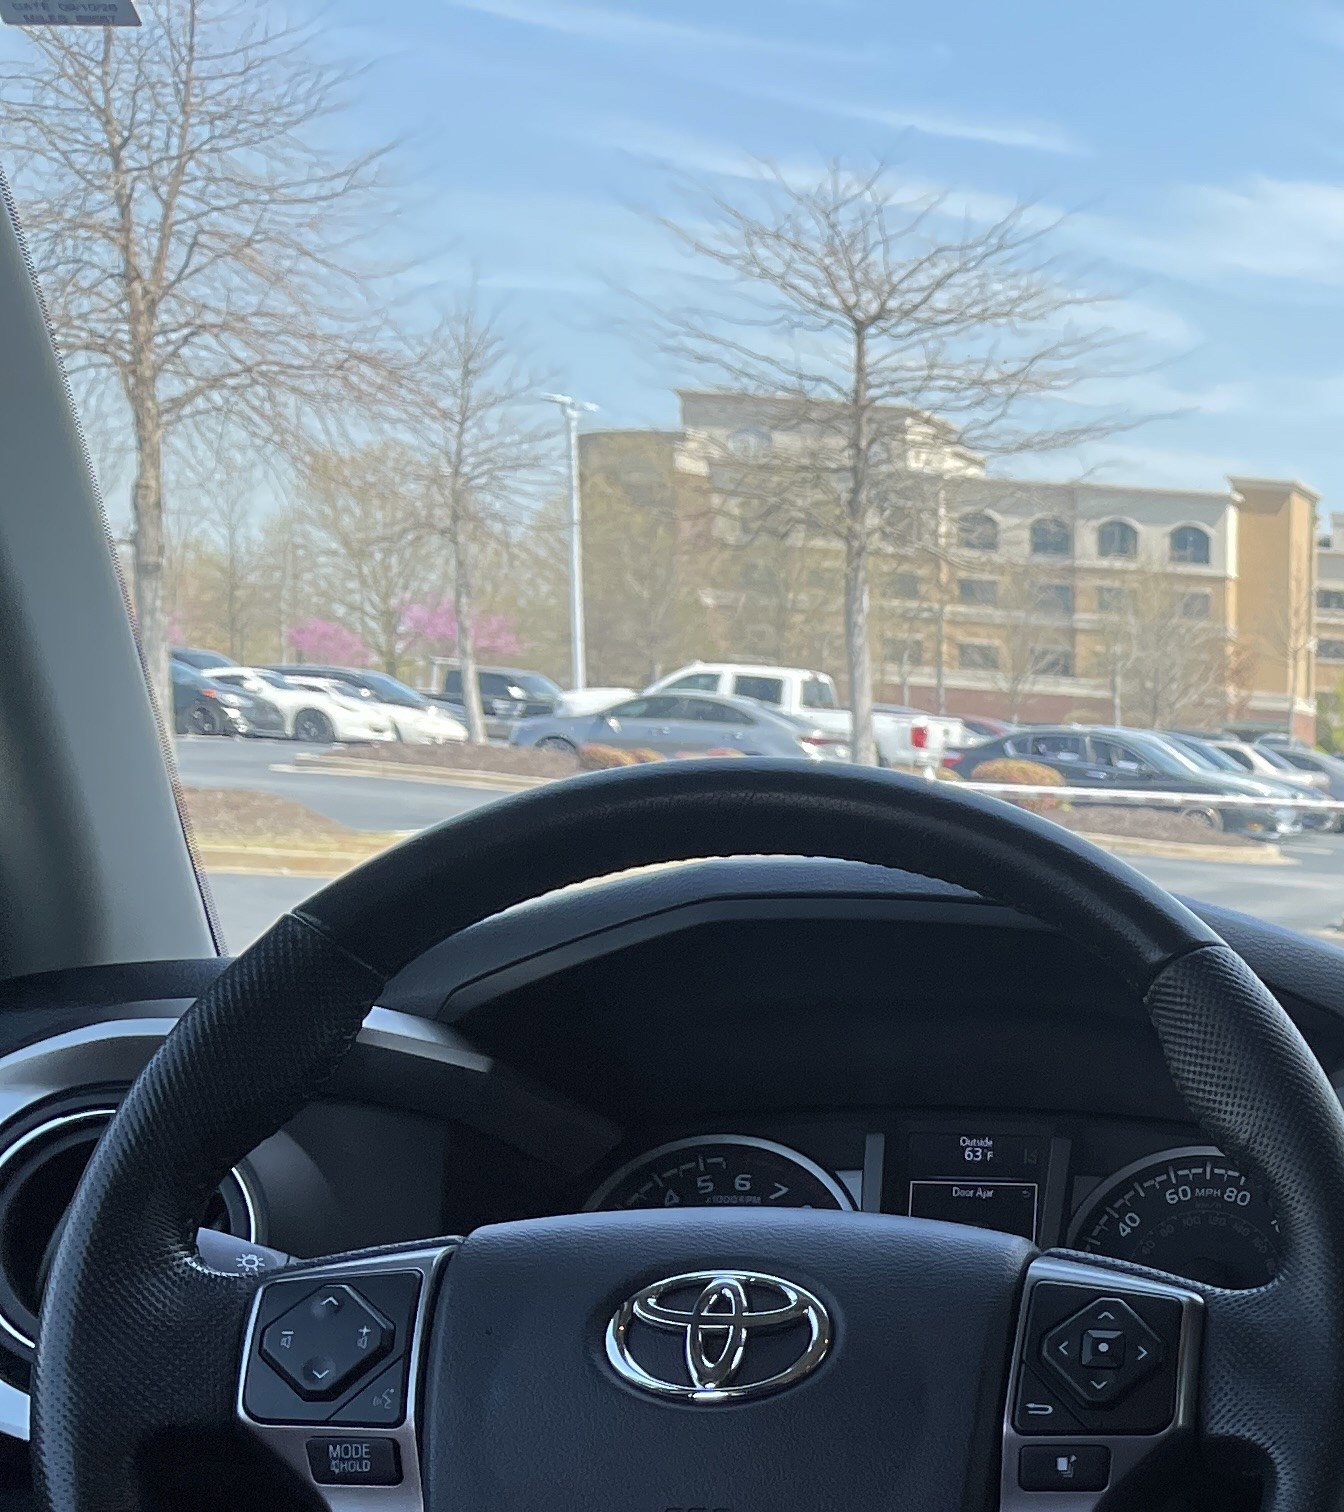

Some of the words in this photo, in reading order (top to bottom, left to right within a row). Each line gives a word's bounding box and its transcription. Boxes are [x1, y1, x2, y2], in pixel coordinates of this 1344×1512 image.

[697, 1175, 714, 1194] 5
[735, 1174, 752, 1191] 6
[1165, 1185, 1192, 1205] 60
[1194, 1188, 1221, 1198] MPH
[1223, 1186, 1251, 1207] 80
[1118, 1212, 1142, 1238] 40
[328, 1443, 372, 1459] MODE
[340, 1460, 372, 1473] HOLD
